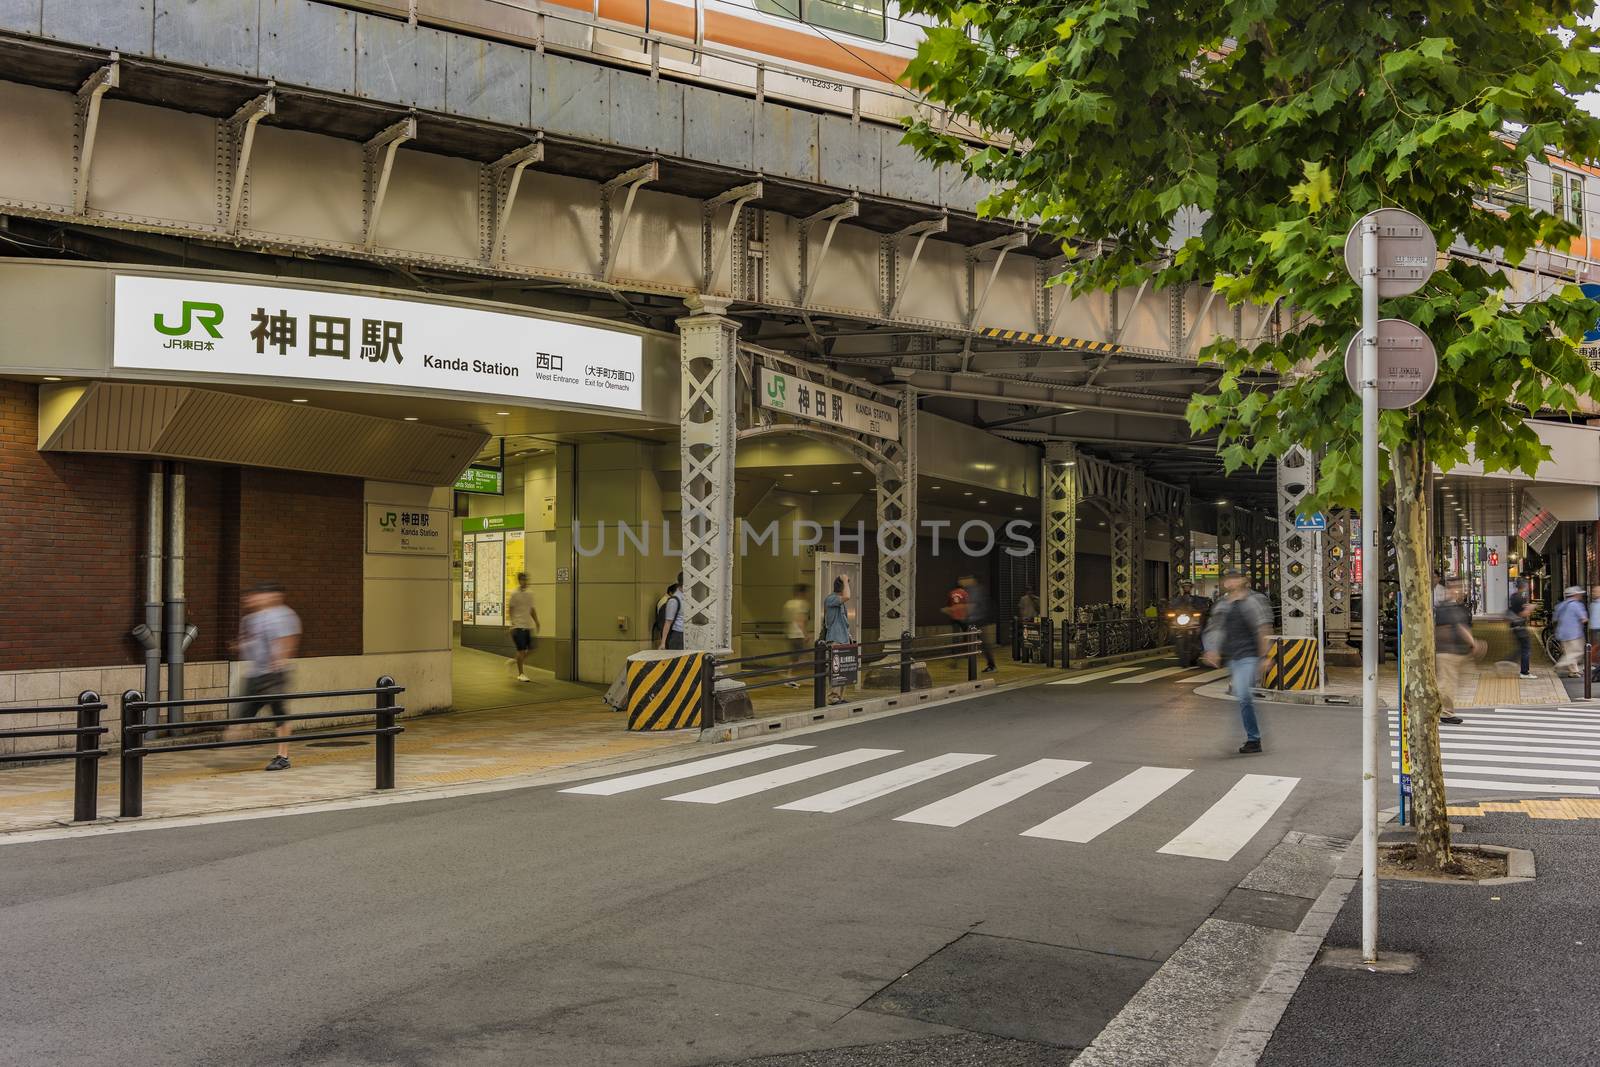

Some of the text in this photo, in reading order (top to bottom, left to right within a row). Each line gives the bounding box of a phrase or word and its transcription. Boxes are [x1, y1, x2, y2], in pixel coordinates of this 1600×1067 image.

[153, 300, 225, 339] JR
[250, 306, 404, 365] 神田駅
[163, 339, 216, 352] JR東日本
[424, 354, 519, 377] Kanda Station
[536, 352, 563, 371] 西口
[535, 372, 579, 384] West Entrance
[584, 378, 596, 388] Exit
[767, 375, 786, 400] JR
[798, 383, 844, 423] 神田駅
[855, 403, 892, 423] KANDA STATION
[379, 512, 397, 527] JR
[401, 512, 430, 527] 神田駅
[400, 527, 419, 536] Kanda
[419, 528, 439, 537] Station
